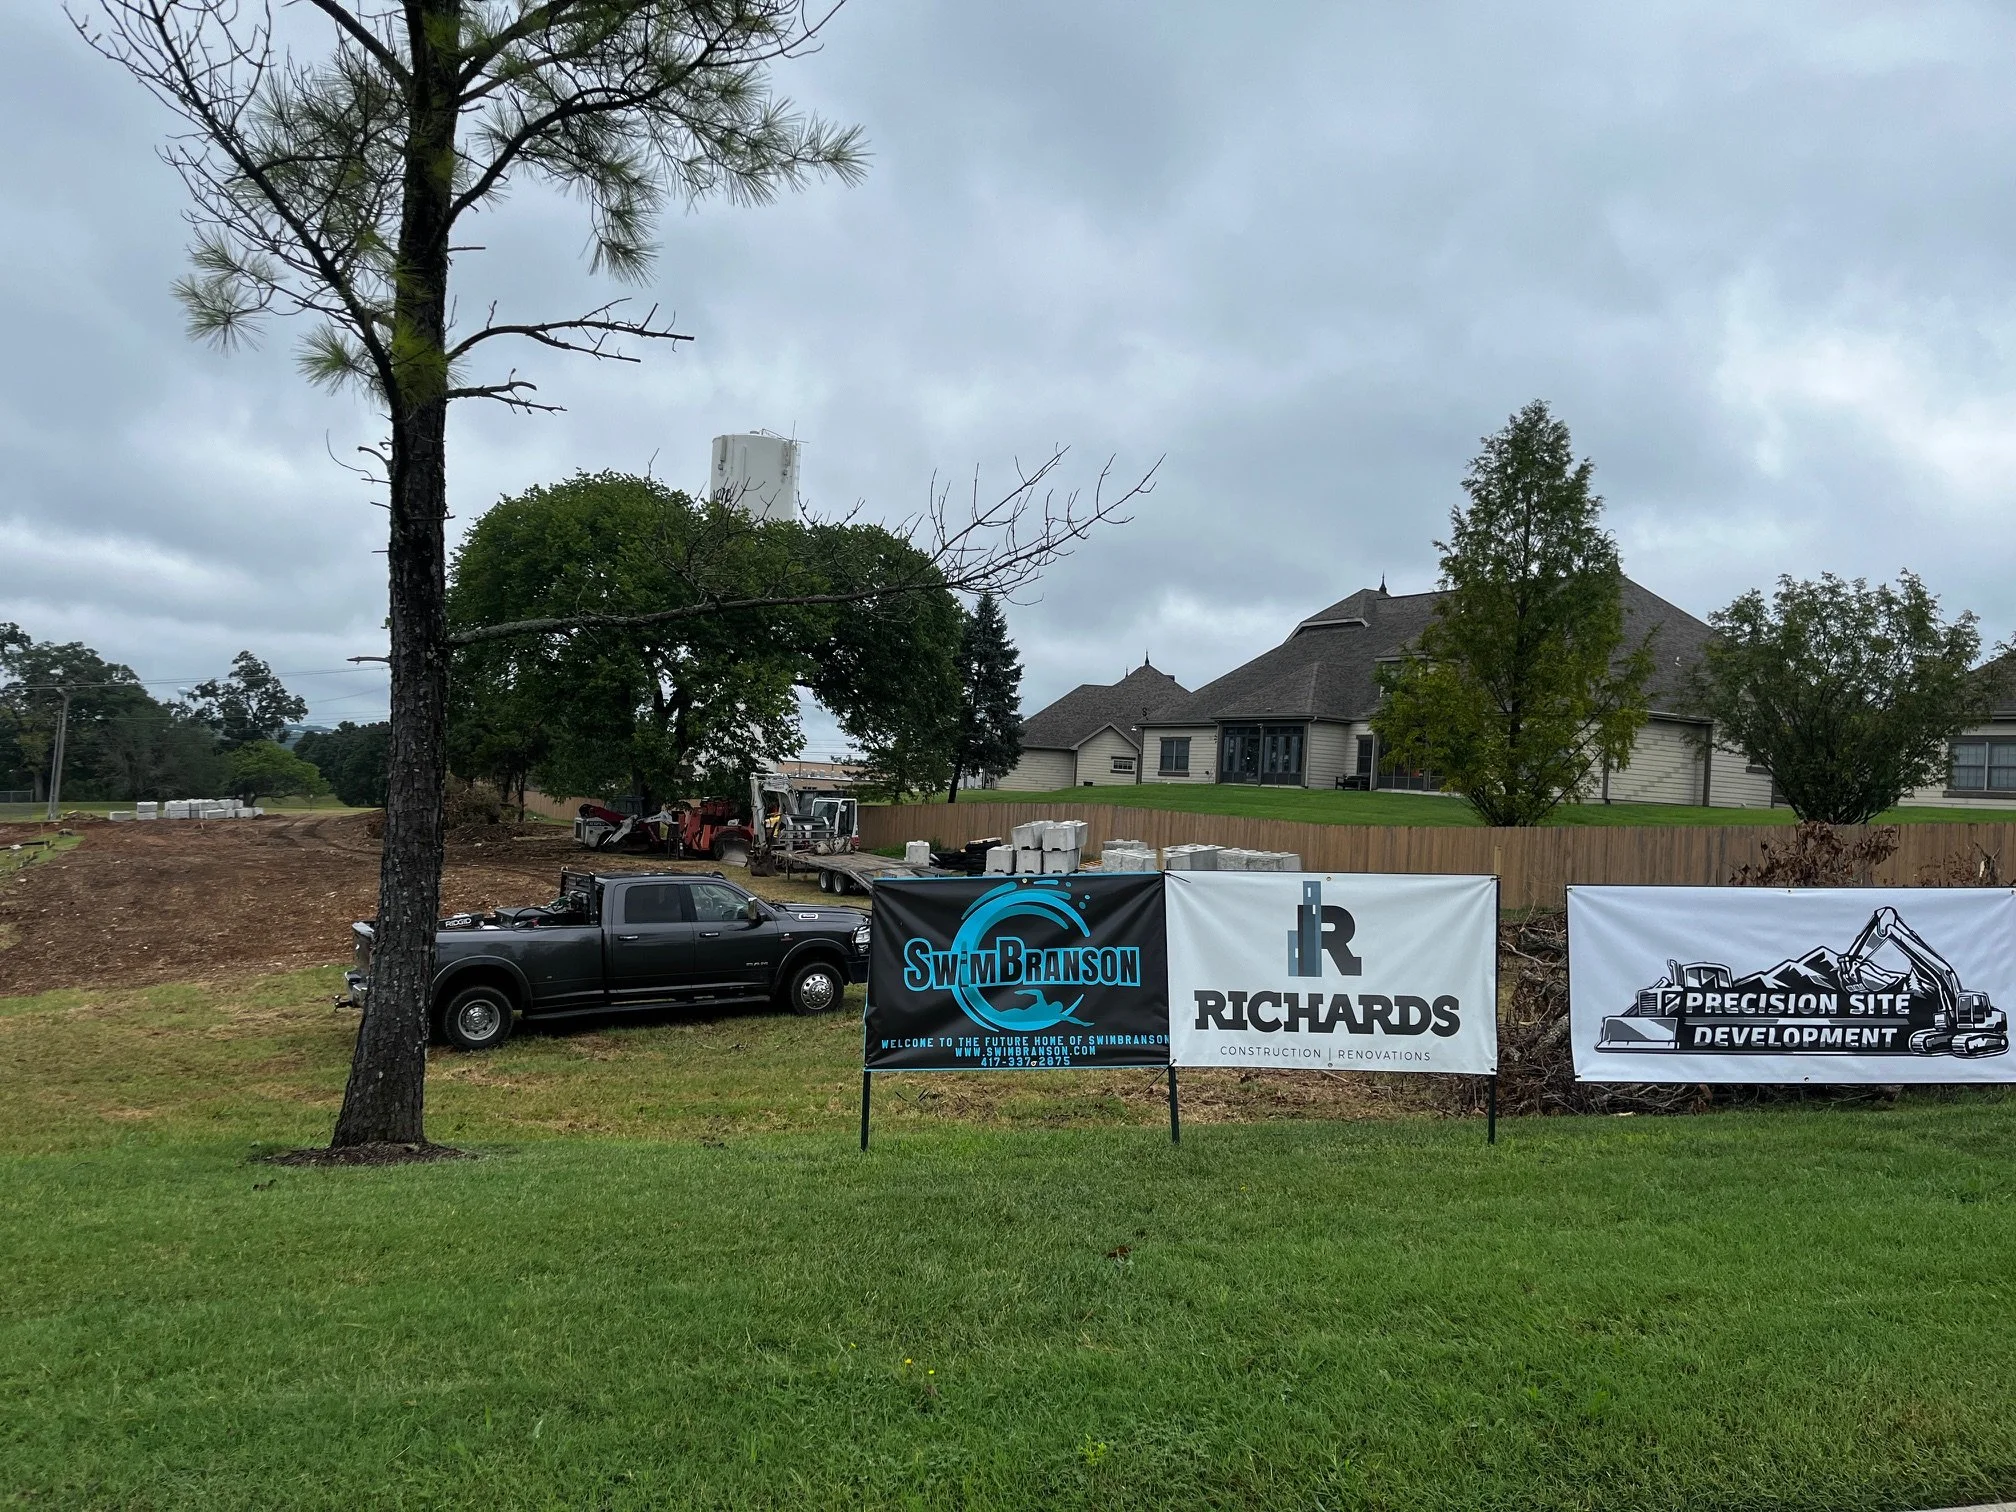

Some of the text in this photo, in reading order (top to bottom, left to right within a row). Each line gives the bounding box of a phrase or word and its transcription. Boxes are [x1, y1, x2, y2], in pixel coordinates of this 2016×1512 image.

[1685, 993, 1910, 1015] PRECISION SITE
[1194, 990, 1461, 1037] RICHARDS
[881, 1034, 1169, 1049] WELCOME TO THE FUTURE HOME OF SWIMBRANSON
[1693, 1027, 1898, 1048] DEVELOPMENT
[955, 1045, 1096, 1057] WWW.SWIMBRANSON.COM
[1220, 1046, 1431, 1061] CONSTRUCTION RENOVATIONS
